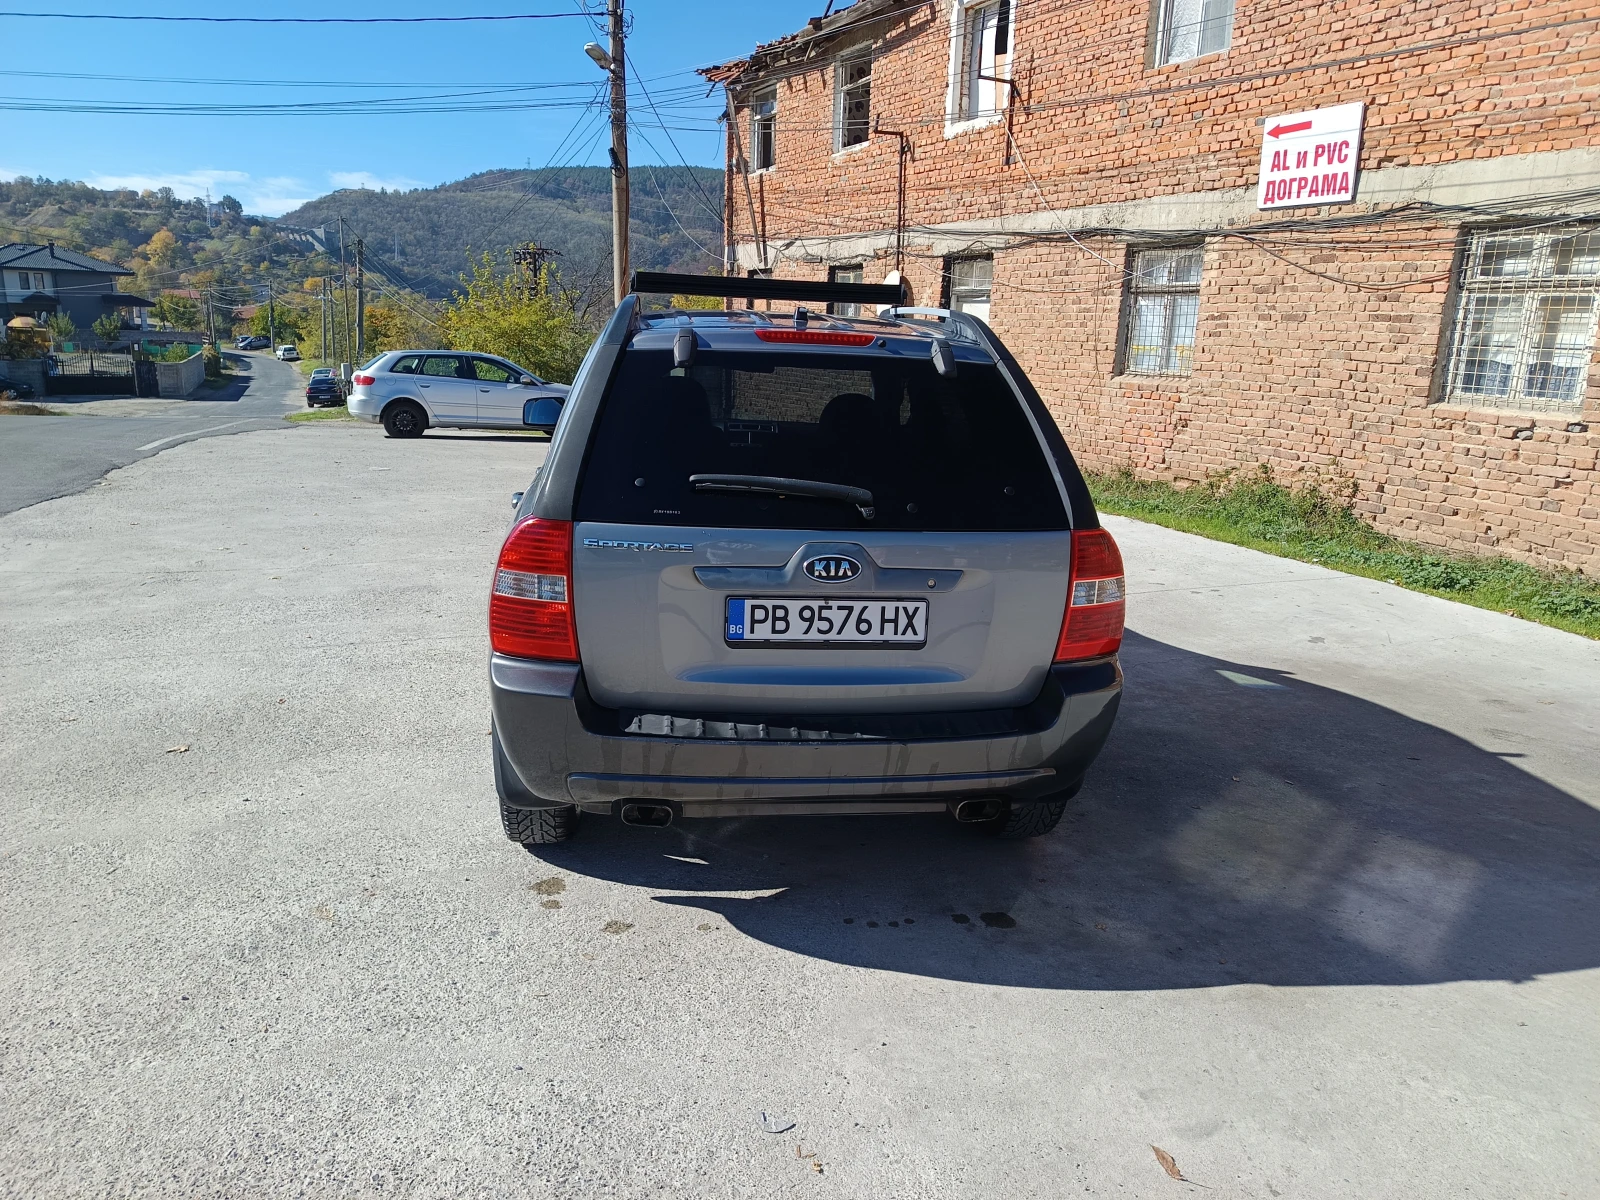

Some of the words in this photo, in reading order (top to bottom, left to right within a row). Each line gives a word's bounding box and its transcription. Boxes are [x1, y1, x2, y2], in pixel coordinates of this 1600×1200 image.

[1270, 149, 1290, 172] AL
[1296, 150, 1308, 169] и
[1313, 140, 1350, 167] PVC
[1263, 171, 1350, 205] ДОГРАМА
[583, 538, 694, 553] SPORTAGE
[814, 560, 852, 577] KIA
[729, 624, 743, 634] BG
[749, 604, 791, 635] PB
[798, 605, 873, 636] 9576
[879, 605, 921, 636] HX
